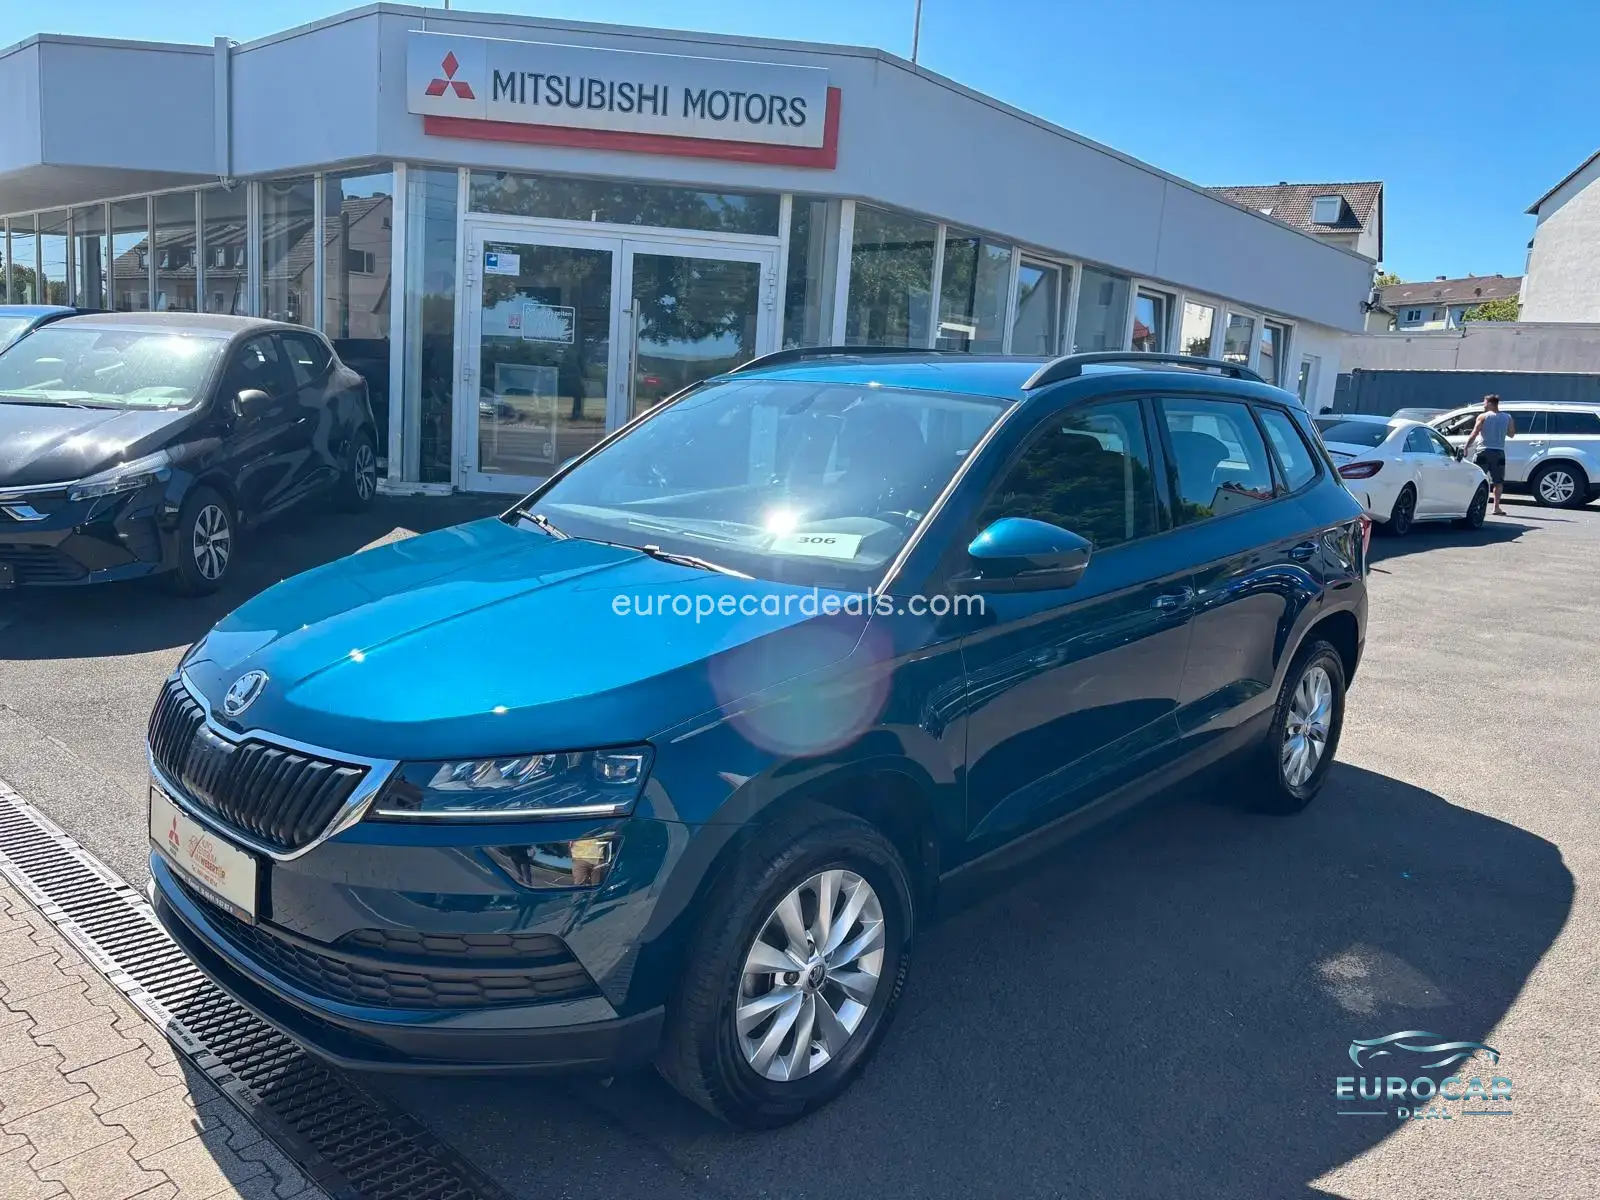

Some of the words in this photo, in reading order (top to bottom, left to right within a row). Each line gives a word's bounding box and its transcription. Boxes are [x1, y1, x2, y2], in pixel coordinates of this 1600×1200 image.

[492, 68, 669, 117] MITSUBISHI
[683, 86, 808, 127] MOTORS
[798, 536, 837, 545] 306
